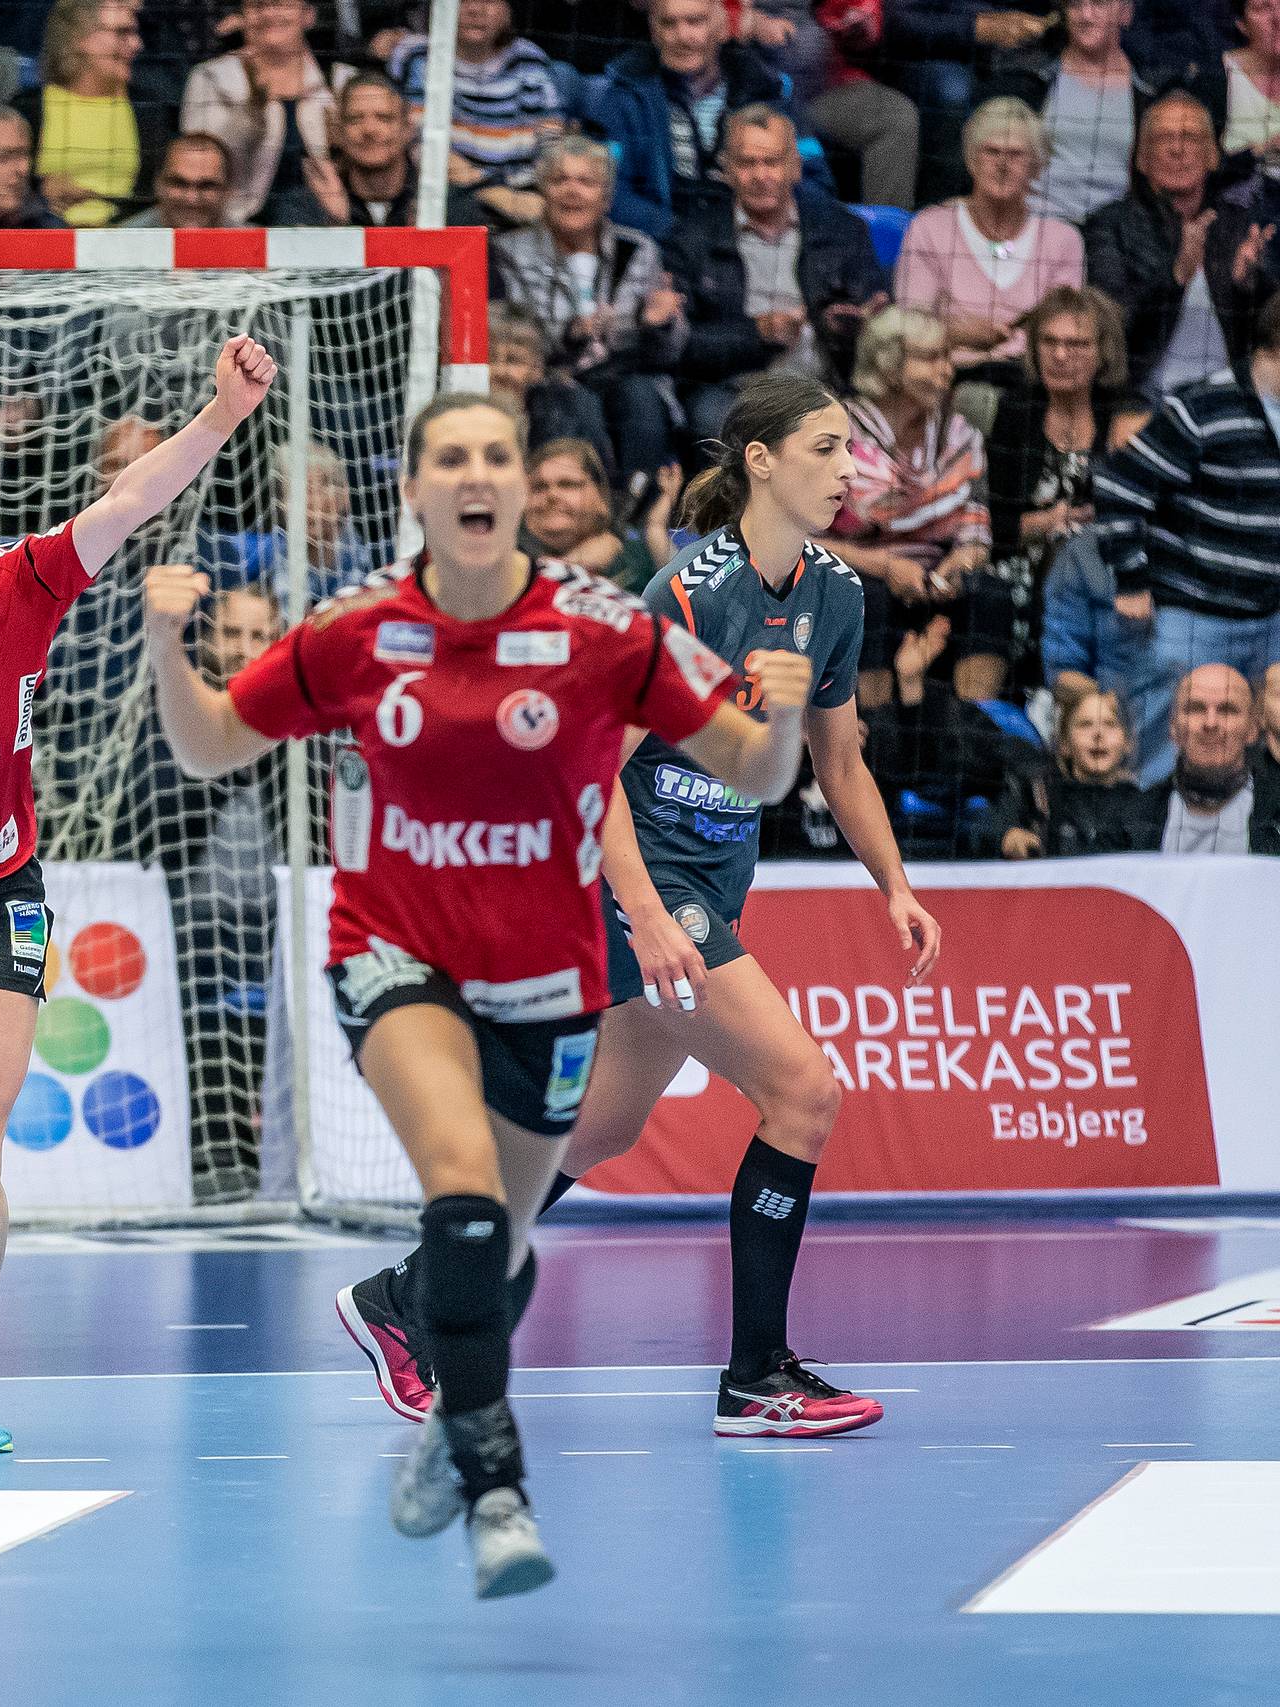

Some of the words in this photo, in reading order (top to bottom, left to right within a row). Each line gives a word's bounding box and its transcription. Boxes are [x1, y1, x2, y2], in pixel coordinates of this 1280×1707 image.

[376, 671, 427, 747] 6
[787, 983, 1132, 1038] IDDELFART
[821, 1037, 1138, 1092] AREKASSE
[989, 1101, 1148, 1148] Esbjerg
